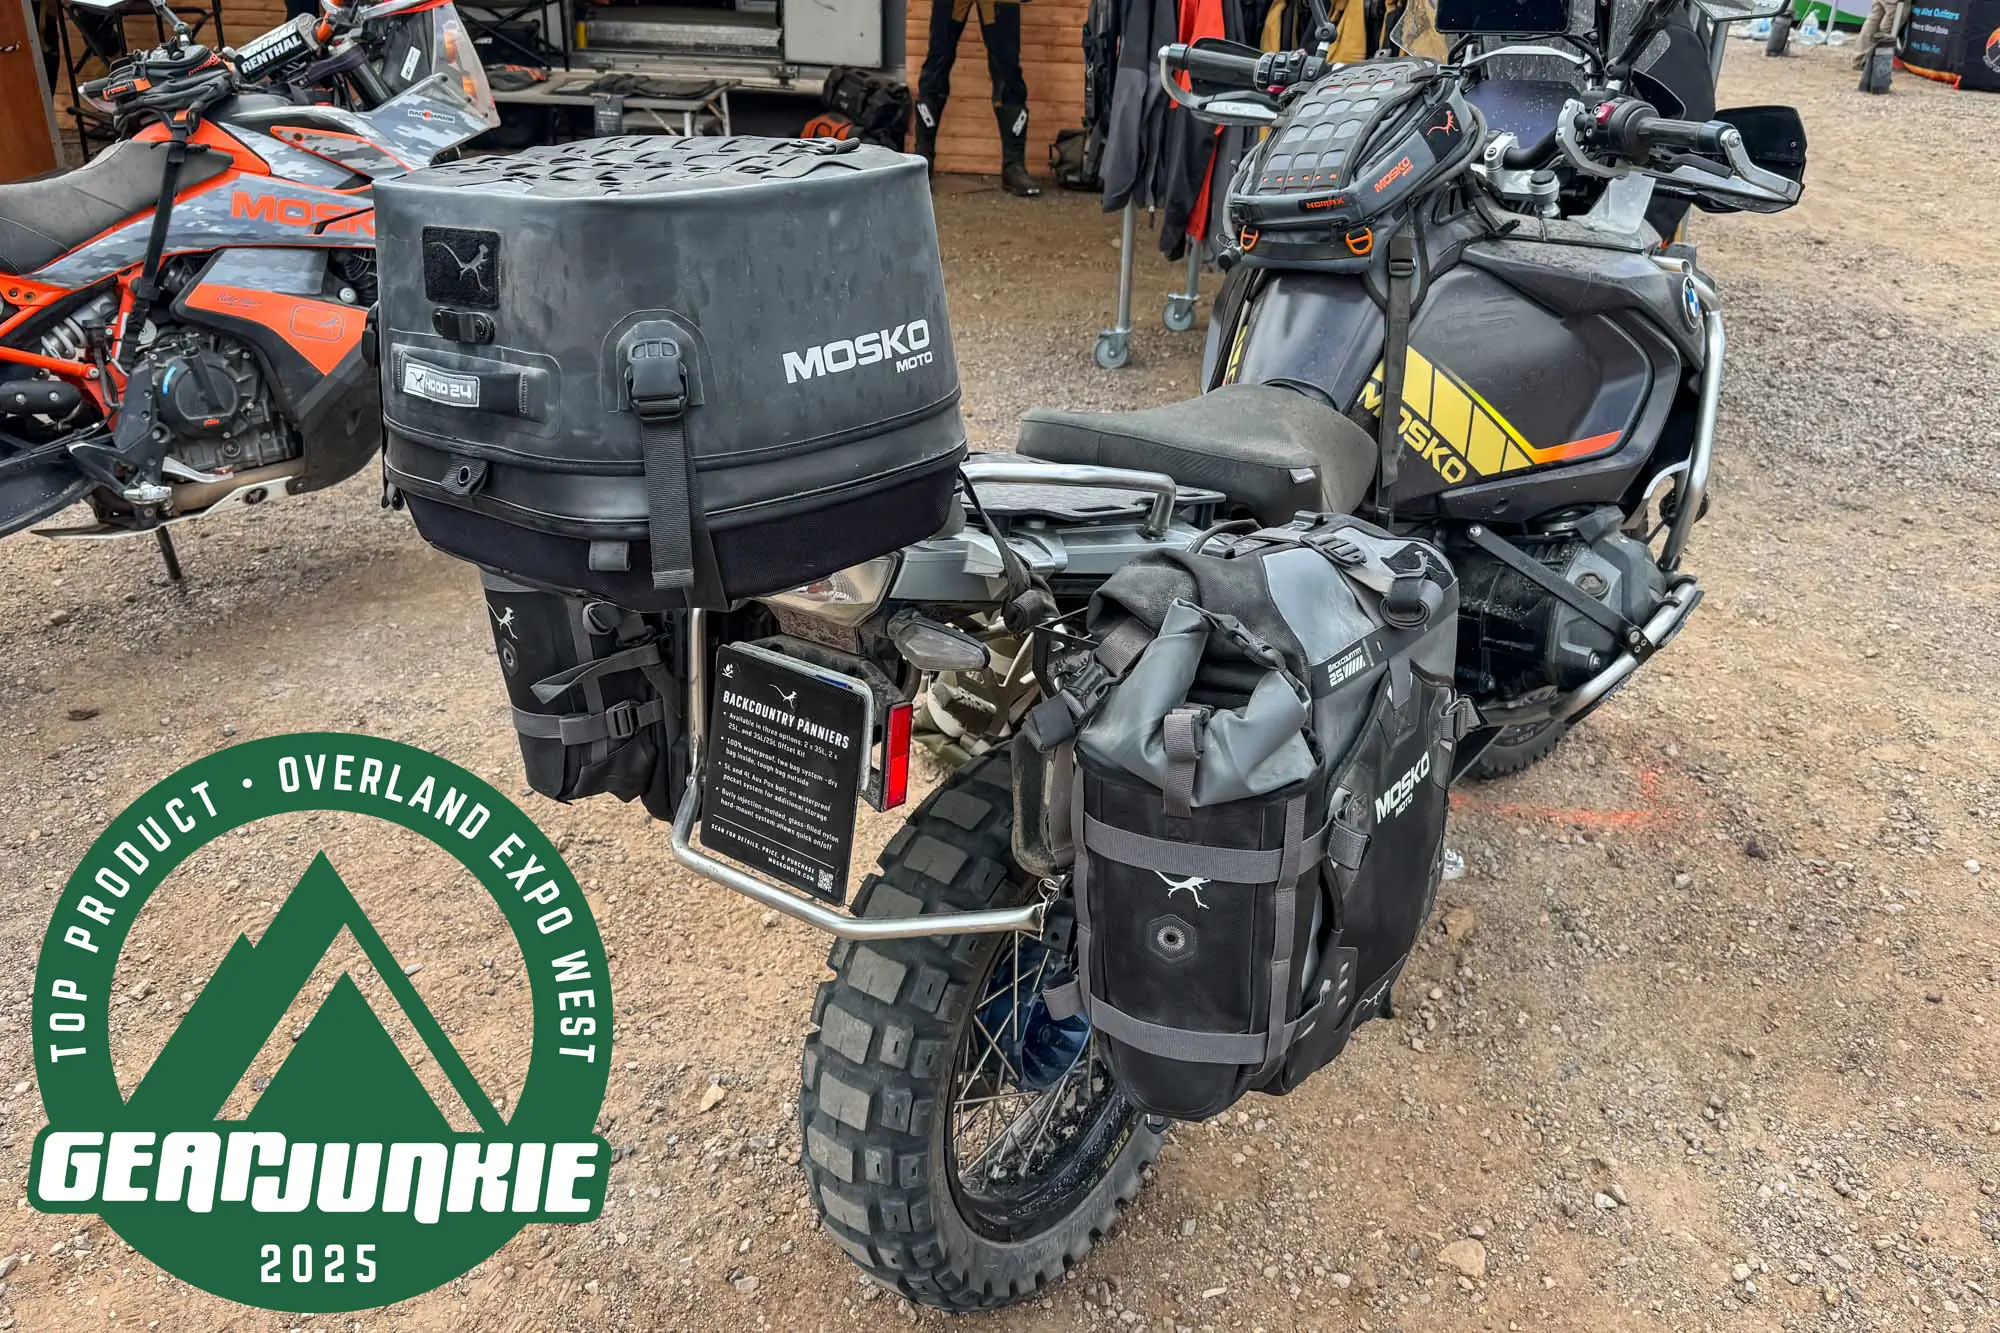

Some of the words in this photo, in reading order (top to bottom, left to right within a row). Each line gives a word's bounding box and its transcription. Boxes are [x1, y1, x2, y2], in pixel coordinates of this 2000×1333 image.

[241, 34, 302, 74] RENTHAL
[1374, 156, 1411, 192] MOSKO
[782, 319, 930, 384] MOSKO
[896, 351, 933, 373] MOTO
[425, 379, 448, 395] HOOD
[450, 384, 472, 399] 24
[1329, 668, 1344, 687] 25
[722, 690, 795, 728] BACKCOUNTRY
[797, 718, 850, 749] PANNIERS
[730, 712, 754, 728] Available
[762, 724, 778, 736] three
[727, 738, 742, 750] 100%
[790, 762, 800, 774] bag
[802, 768, 823, 782] system
[742, 728, 752, 736] and
[754, 732, 776, 747] 35L/25L
[778, 742, 796, 754] Offset
[797, 749, 806, 758] Kit
[726, 748, 736, 758] bag
[758, 760, 774, 774] tough
[775, 768, 786, 779] bag
[787, 773, 809, 786] outside
[1375, 751, 1430, 824] MOSKO
[723, 774, 742, 786] pocket
[744, 782, 764, 795] system
[765, 790, 773, 799] for
[774, 794, 804, 812] additional
[804, 807, 828, 822] storage
[732, 766, 742, 776] and
[775, 784, 796, 798] bolt-on
[798, 794, 830, 812] waterproof
[1395, 792, 1412, 818] MOTO
[720, 798, 754, 817] hard-mount
[755, 814, 776, 827] system
[776, 822, 795, 835] allows
[796, 831, 812, 843] quick
[813, 838, 832, 852] on/off
[722, 788, 736, 800] Burly
[788, 817, 822, 836] glass-filled
[823, 831, 839, 844] nylon
[726, 830, 736, 838] FOR
[786, 857, 816, 874] PURCHASE
